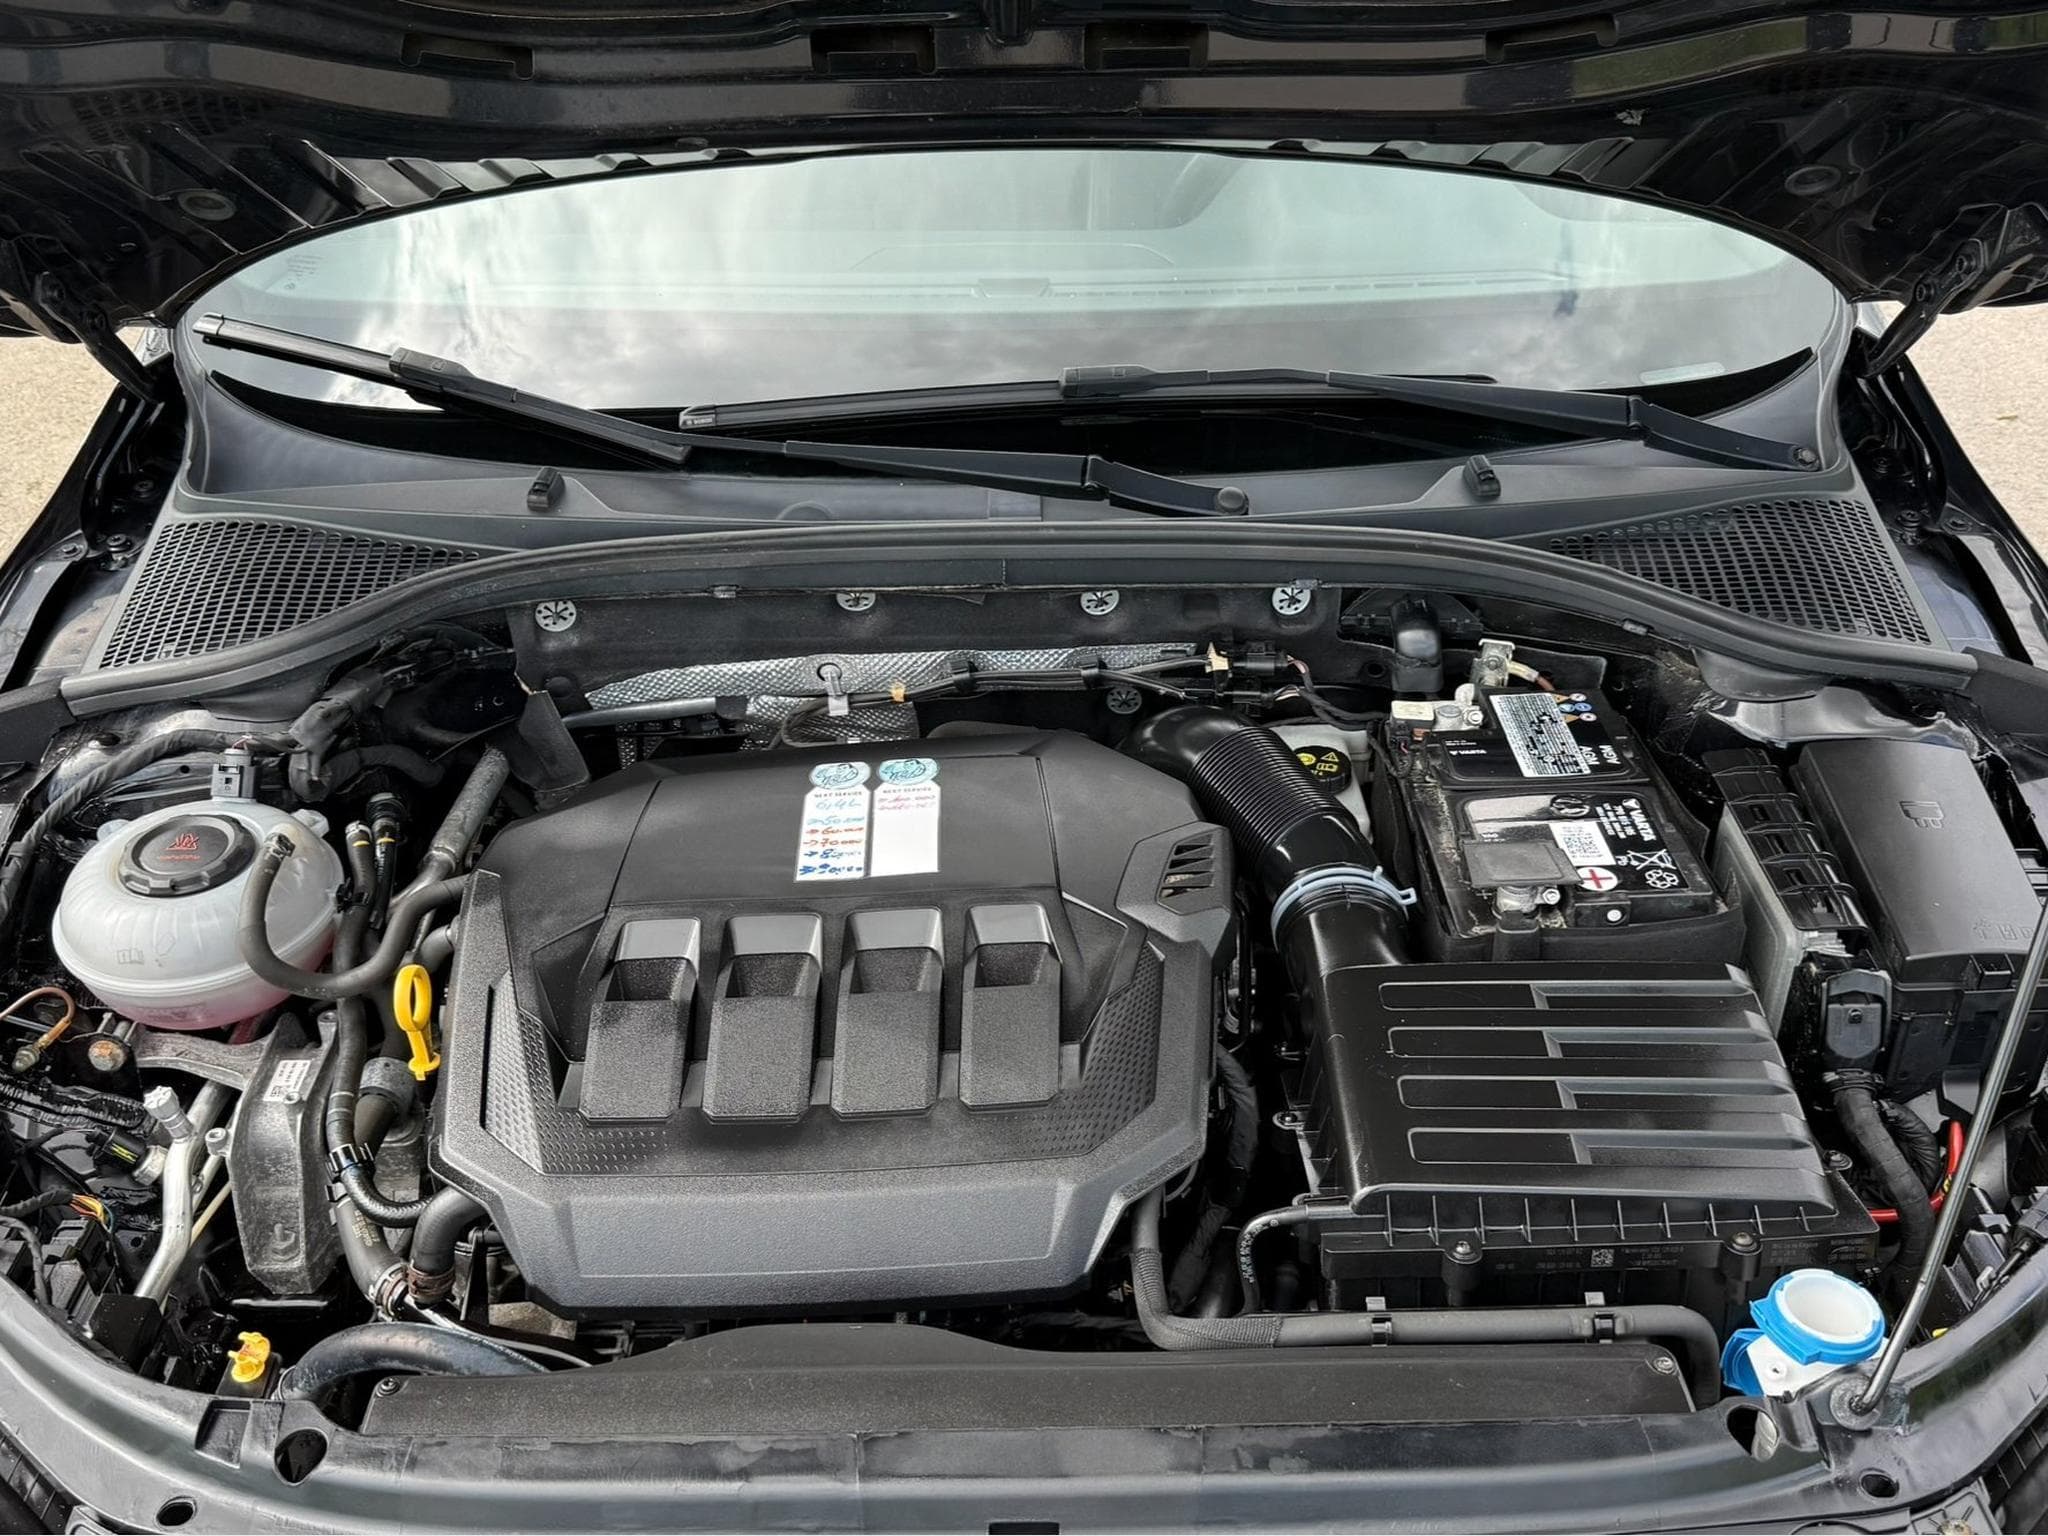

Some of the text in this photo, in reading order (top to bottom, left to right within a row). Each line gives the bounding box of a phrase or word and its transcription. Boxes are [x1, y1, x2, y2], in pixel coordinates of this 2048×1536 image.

[1579, 745, 1600, 765] AGM
[1599, 744, 1621, 764] AGM
[1629, 808, 1657, 842] VARTA
